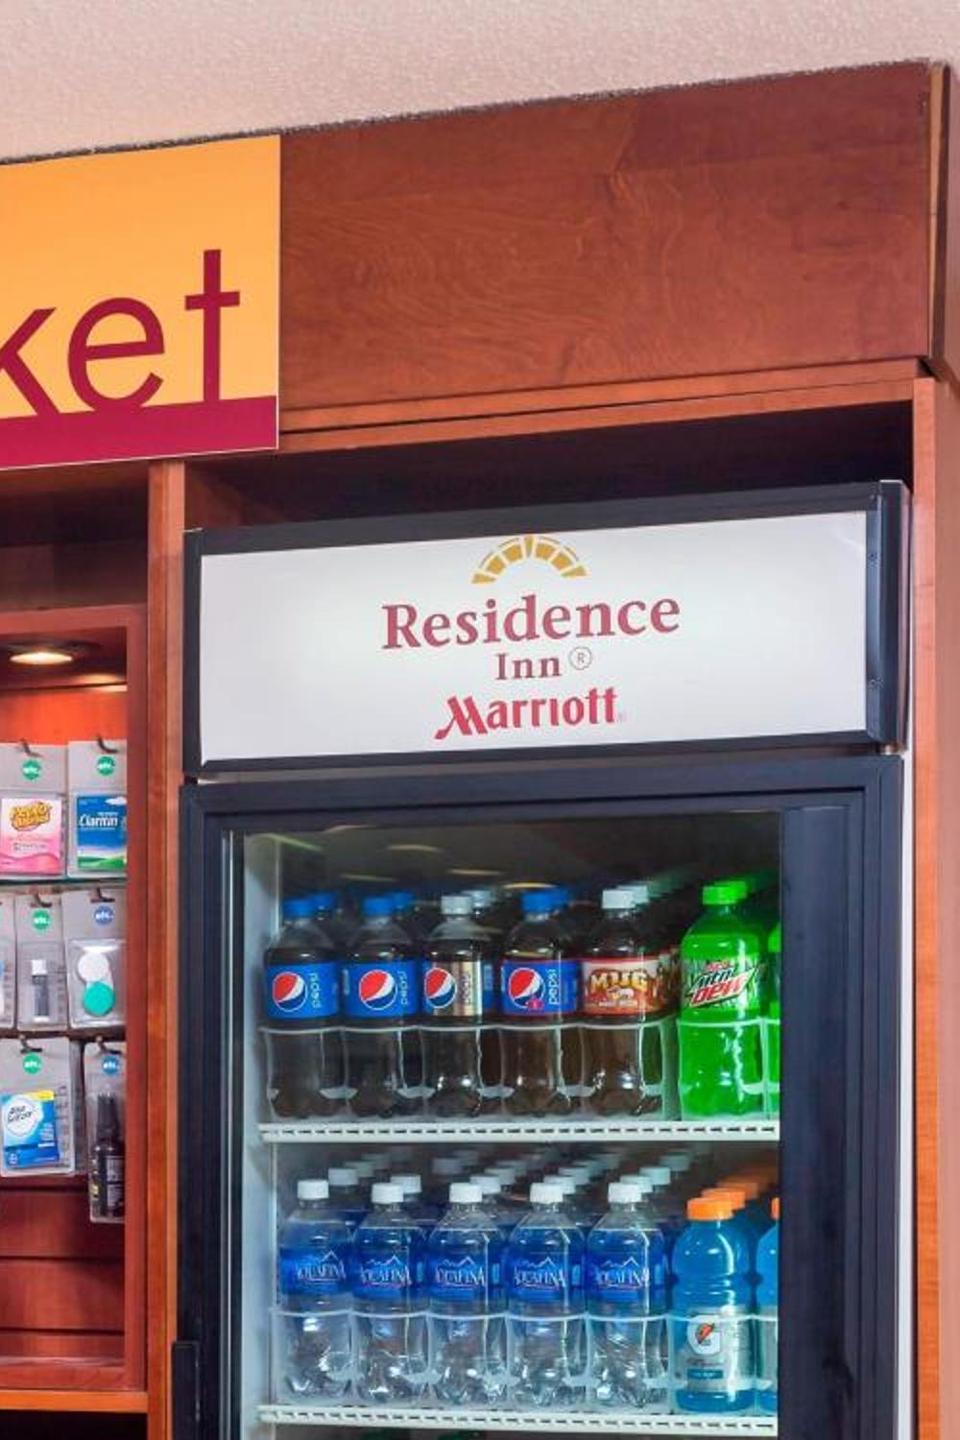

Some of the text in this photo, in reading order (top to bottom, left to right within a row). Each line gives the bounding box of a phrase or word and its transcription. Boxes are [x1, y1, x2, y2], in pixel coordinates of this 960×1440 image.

[382, 593, 681, 649] Residence
[495, 653, 562, 680] Inn
[434, 686, 618, 740] Marriott
[548, 968, 560, 1006] pepsi
[590, 967, 648, 994] MUG
[691, 967, 736, 992] Mtn
